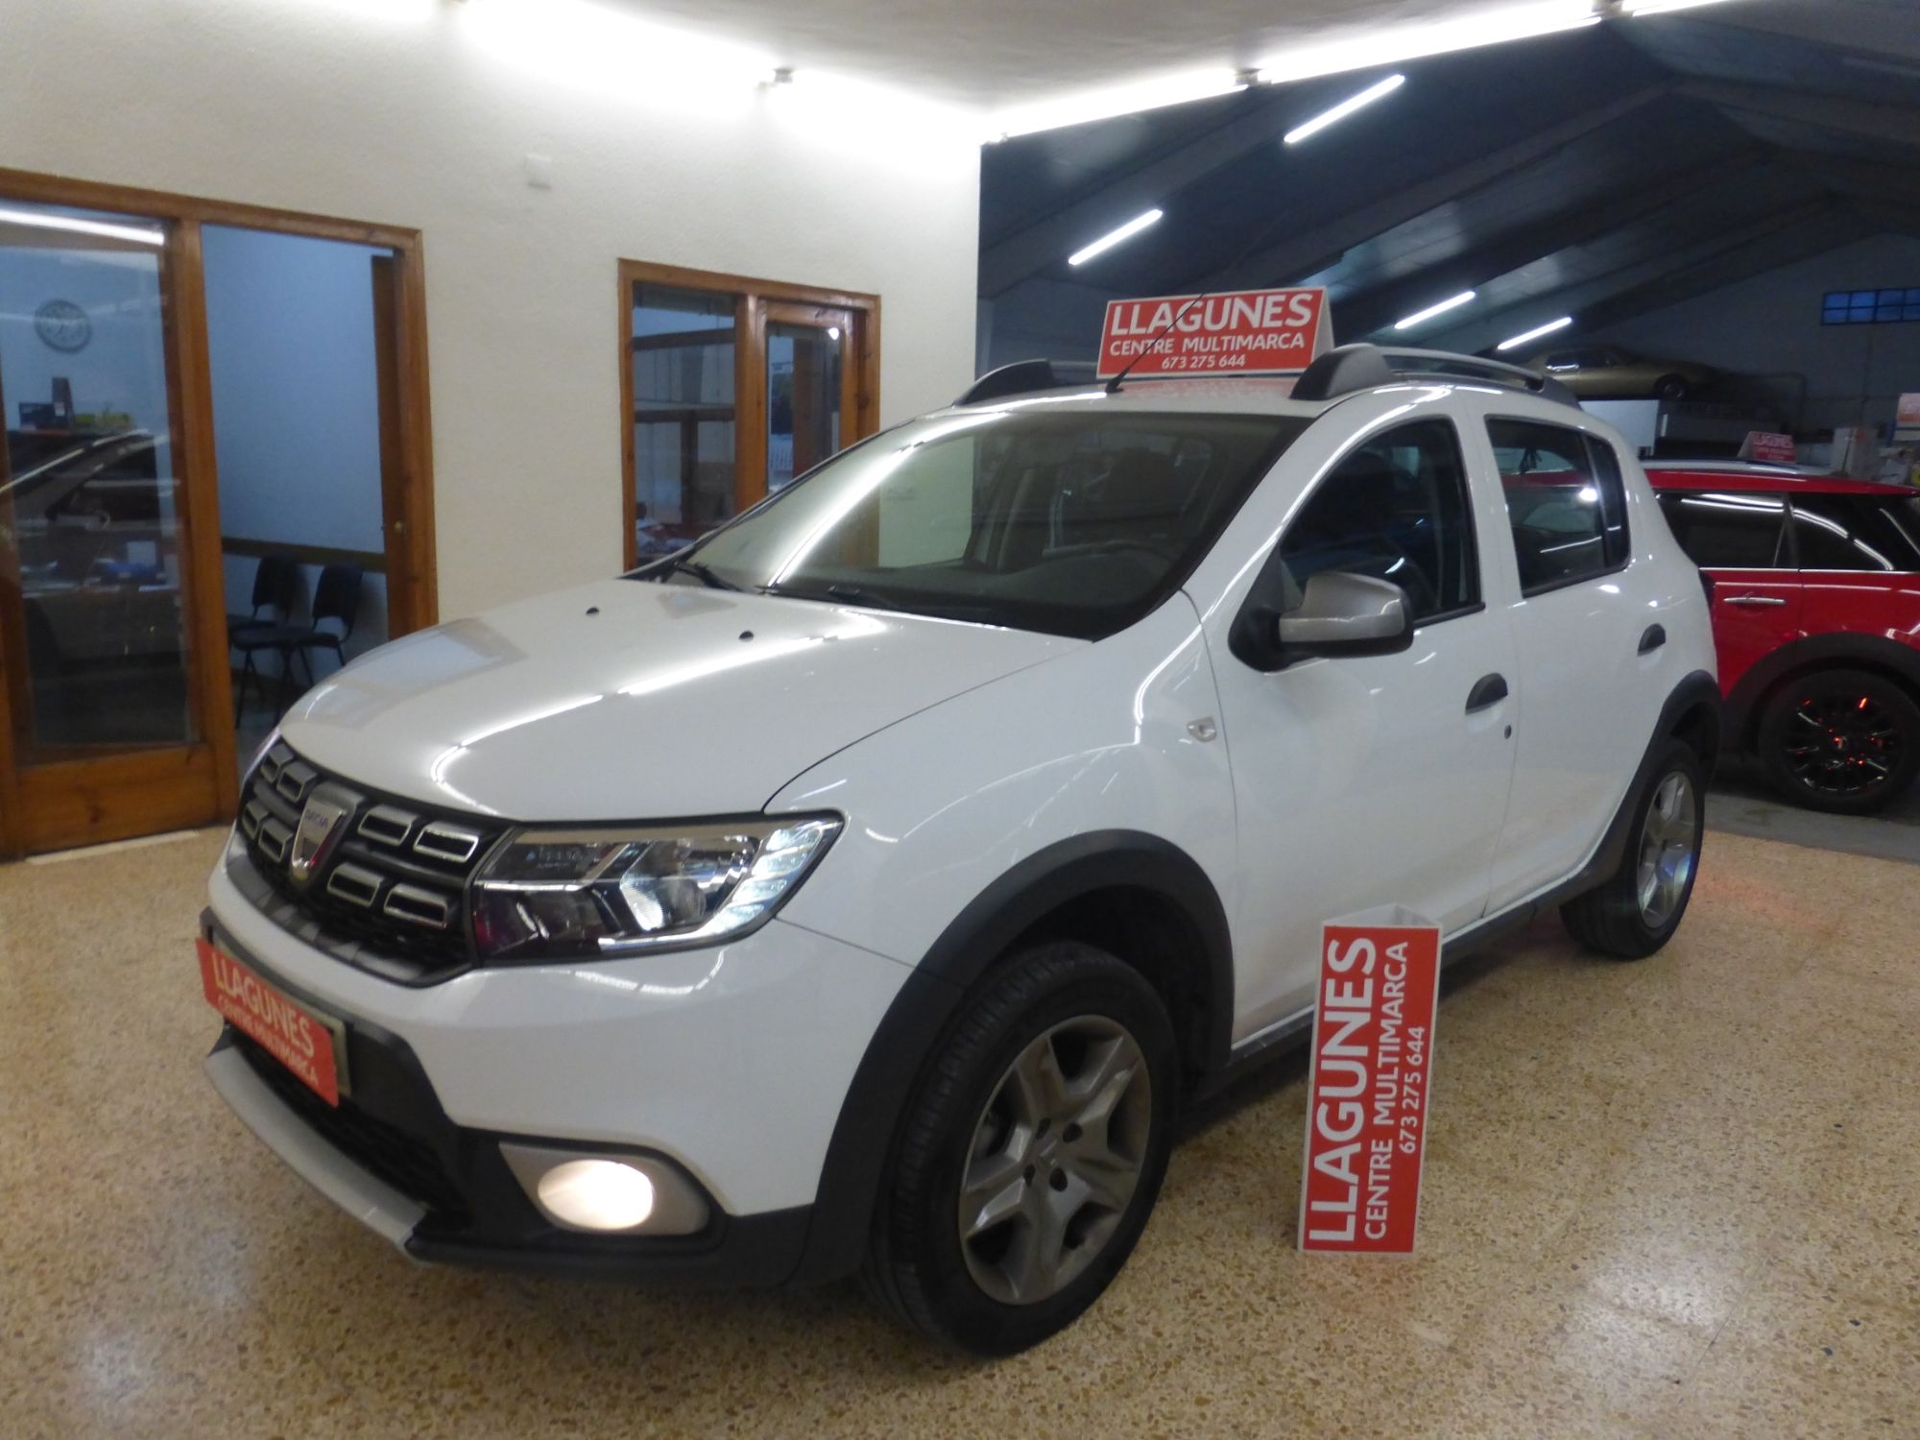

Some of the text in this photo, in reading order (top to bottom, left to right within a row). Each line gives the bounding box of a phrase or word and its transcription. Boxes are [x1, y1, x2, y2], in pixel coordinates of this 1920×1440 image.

[1109, 332, 1305, 356] CENTRE MULTIMARCA
[1110, 293, 1314, 336] LLAGUNES
[1161, 353, 1246, 369] 673 275 644
[211, 951, 315, 1059] LLAGUNES
[1308, 937, 1377, 1242] LLAGUNES
[1364, 941, 1409, 1240] CENTRE MULTIMARCA
[1399, 1025, 1425, 1155] 673 275 644
